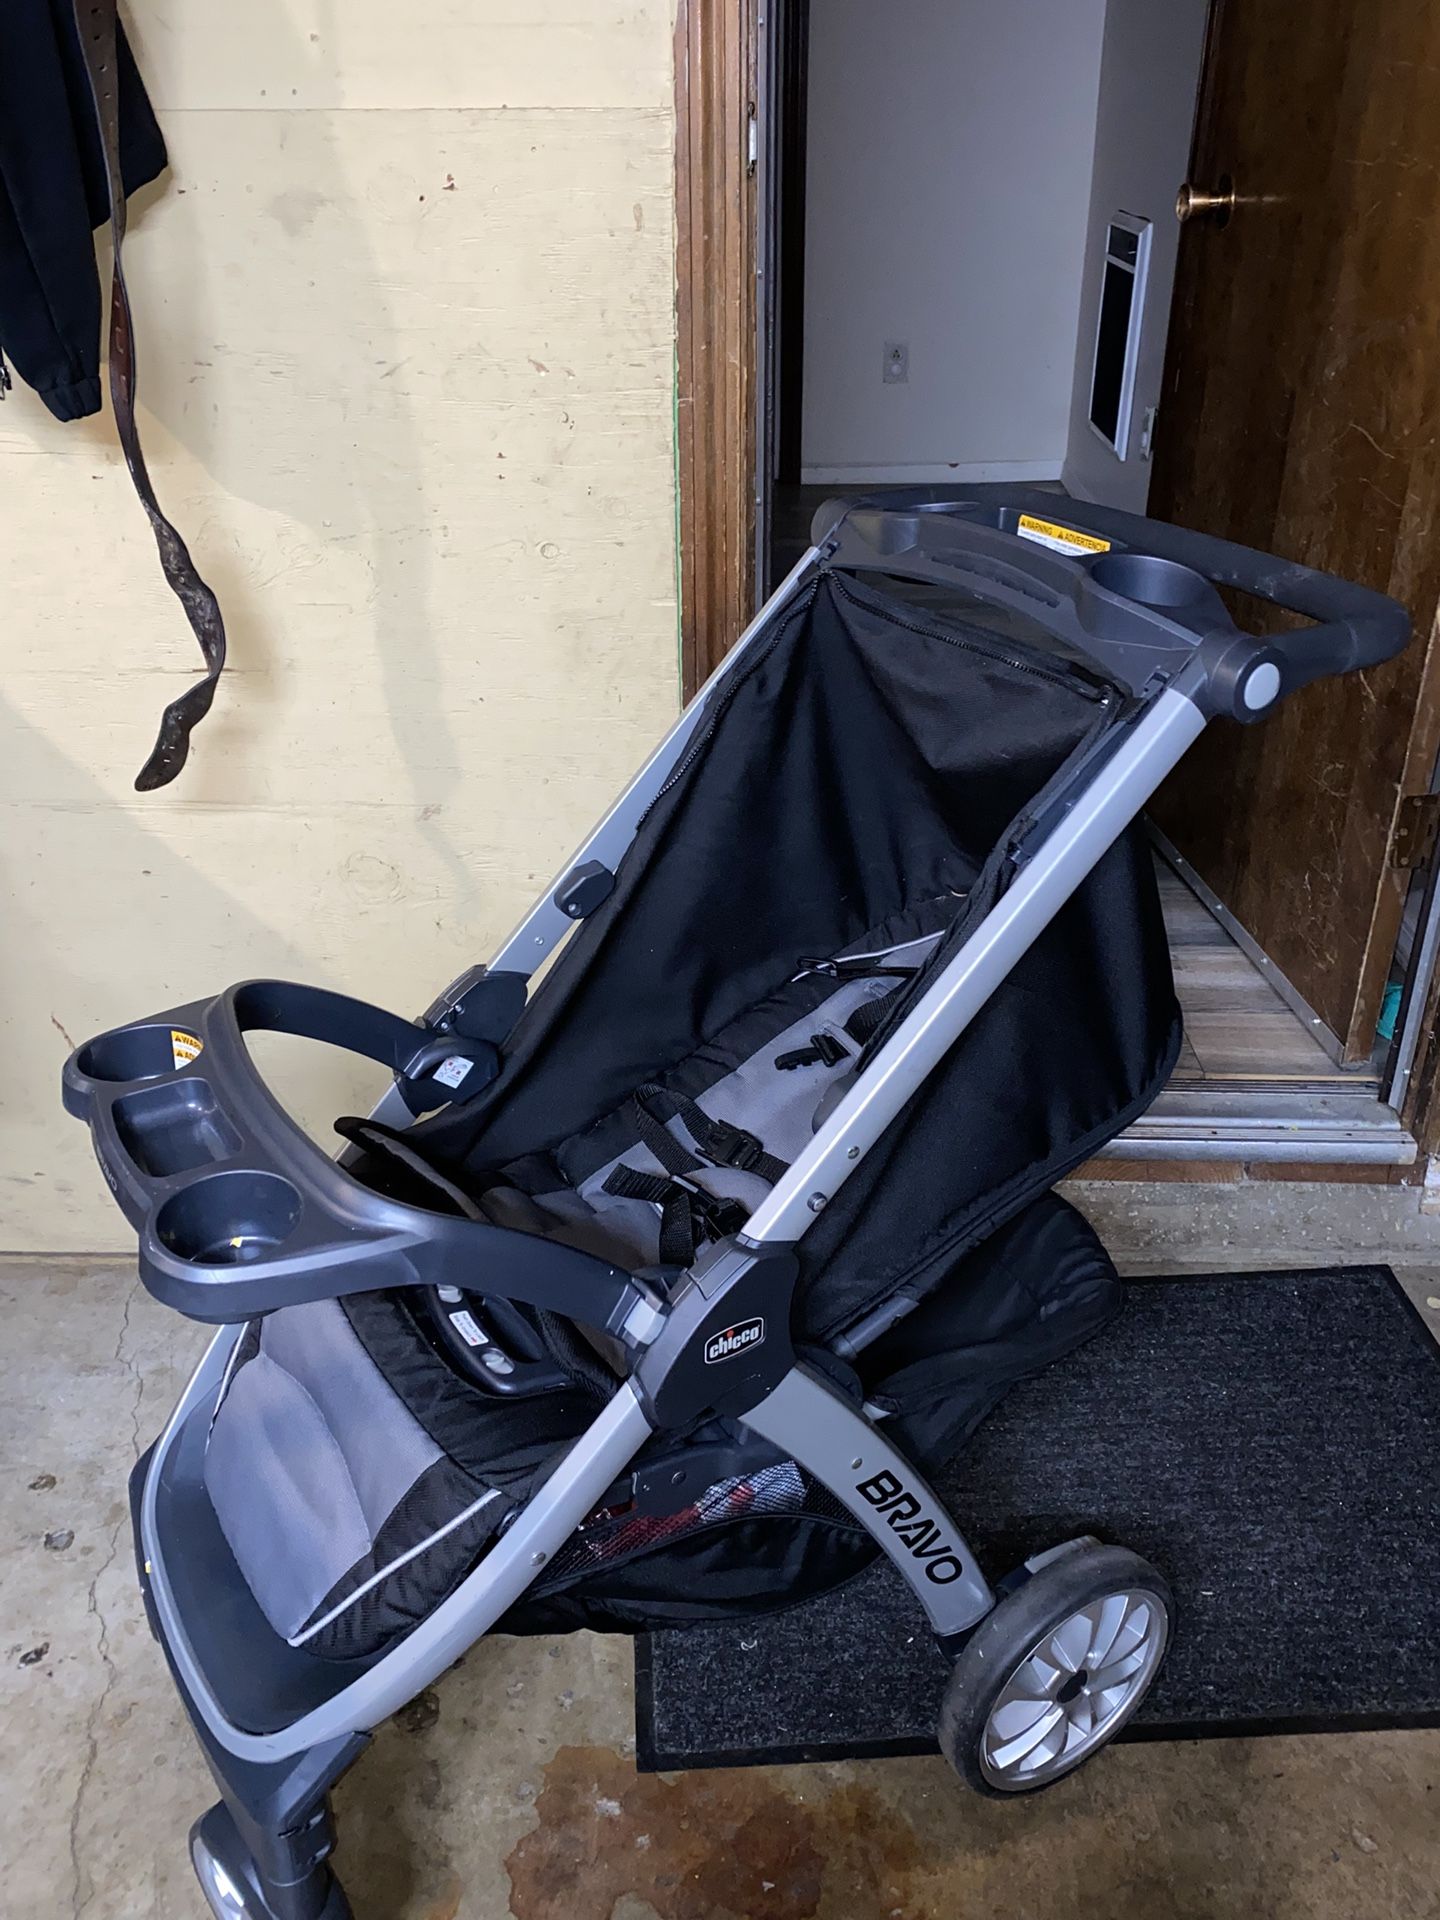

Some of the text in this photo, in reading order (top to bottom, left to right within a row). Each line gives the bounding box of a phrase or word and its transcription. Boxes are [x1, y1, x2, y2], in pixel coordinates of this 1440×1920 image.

[1027, 518, 1053, 536] WARNING
[709, 1328, 759, 1359] chicco
[855, 1469, 963, 1584] BRAVO
